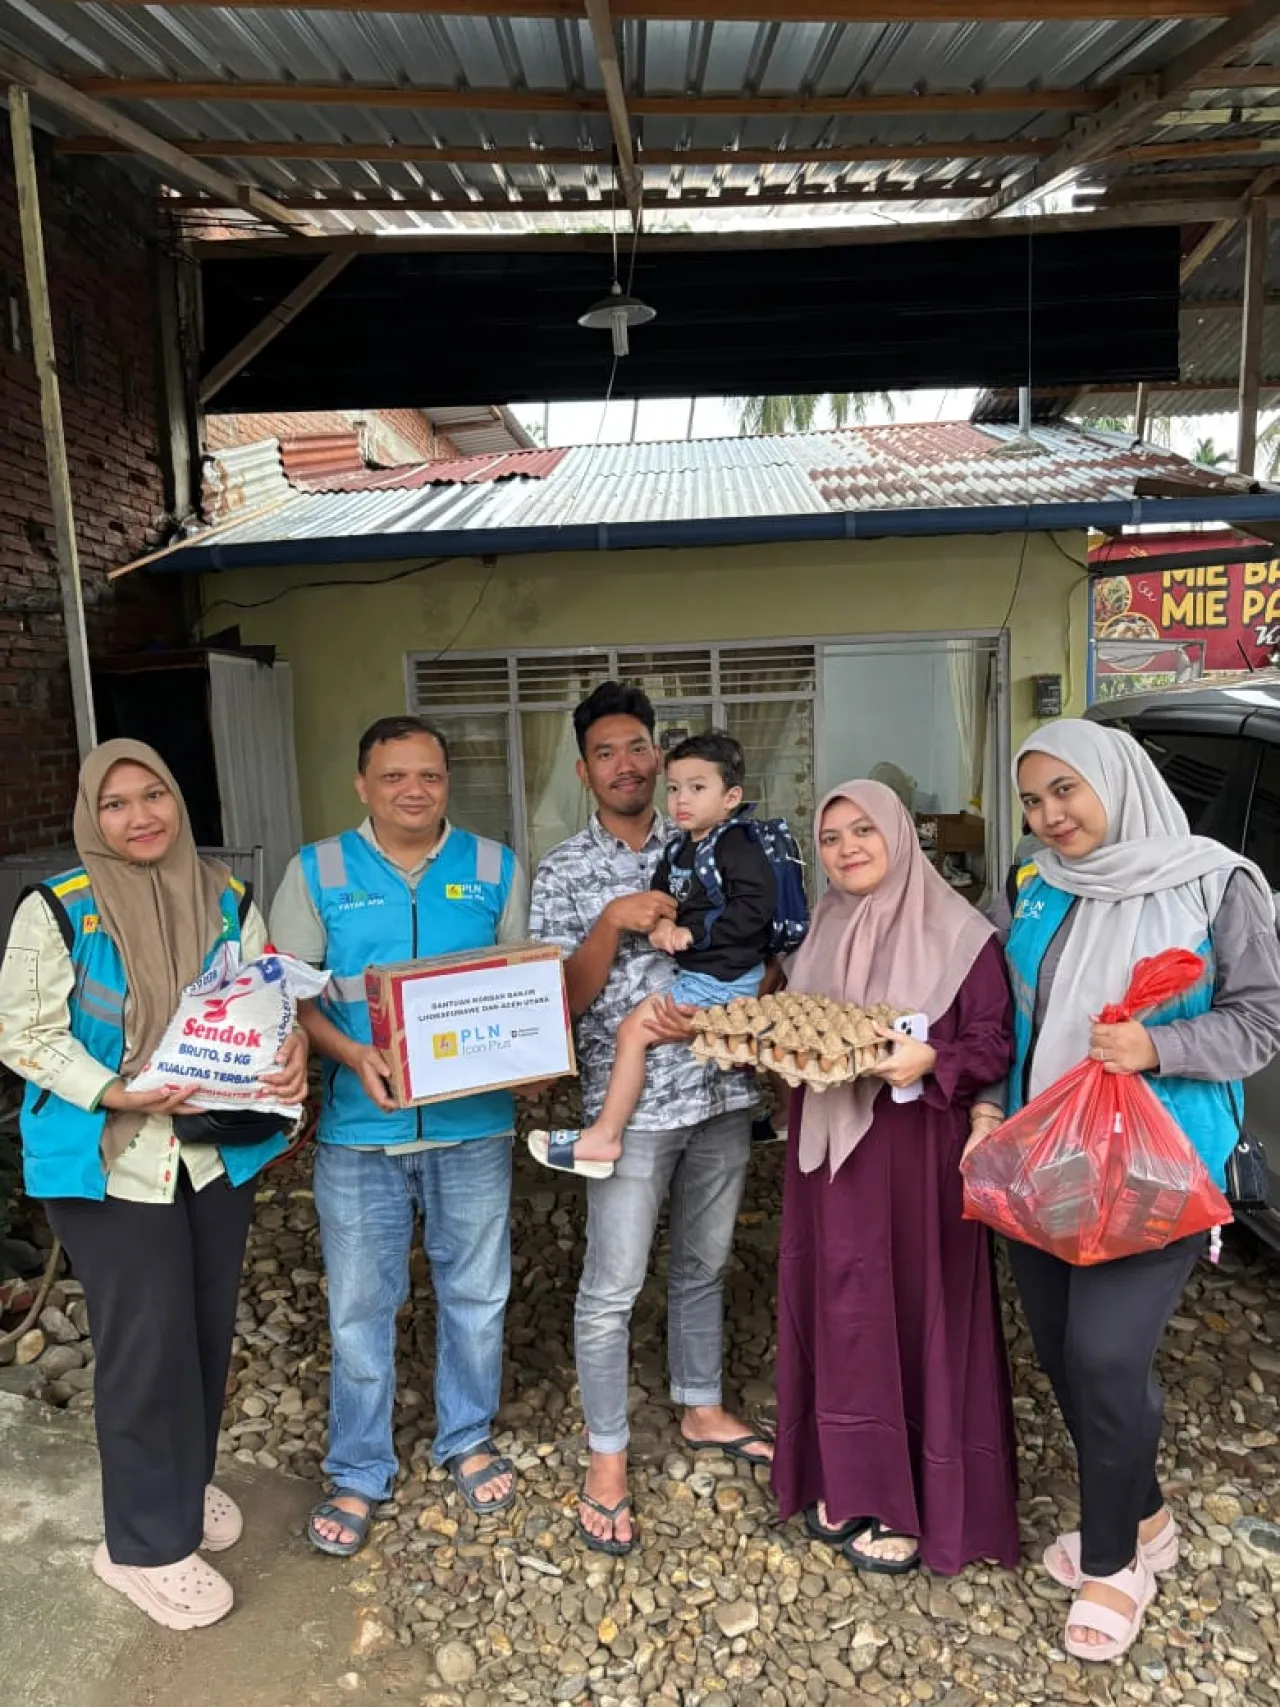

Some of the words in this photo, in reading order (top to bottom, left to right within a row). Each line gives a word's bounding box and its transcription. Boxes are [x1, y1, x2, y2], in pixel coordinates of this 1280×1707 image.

[1163, 565, 1229, 587] MIE
[1162, 591, 1228, 626] MIE
[184, 1018, 262, 1047] Sendok
[460, 1024, 500, 1042] PLN
[179, 1042, 220, 1062] BRUTO,
[223, 1052, 232, 1063] 5
[234, 1053, 252, 1065] KG
[157, 1061, 210, 1079] KUALITAS
